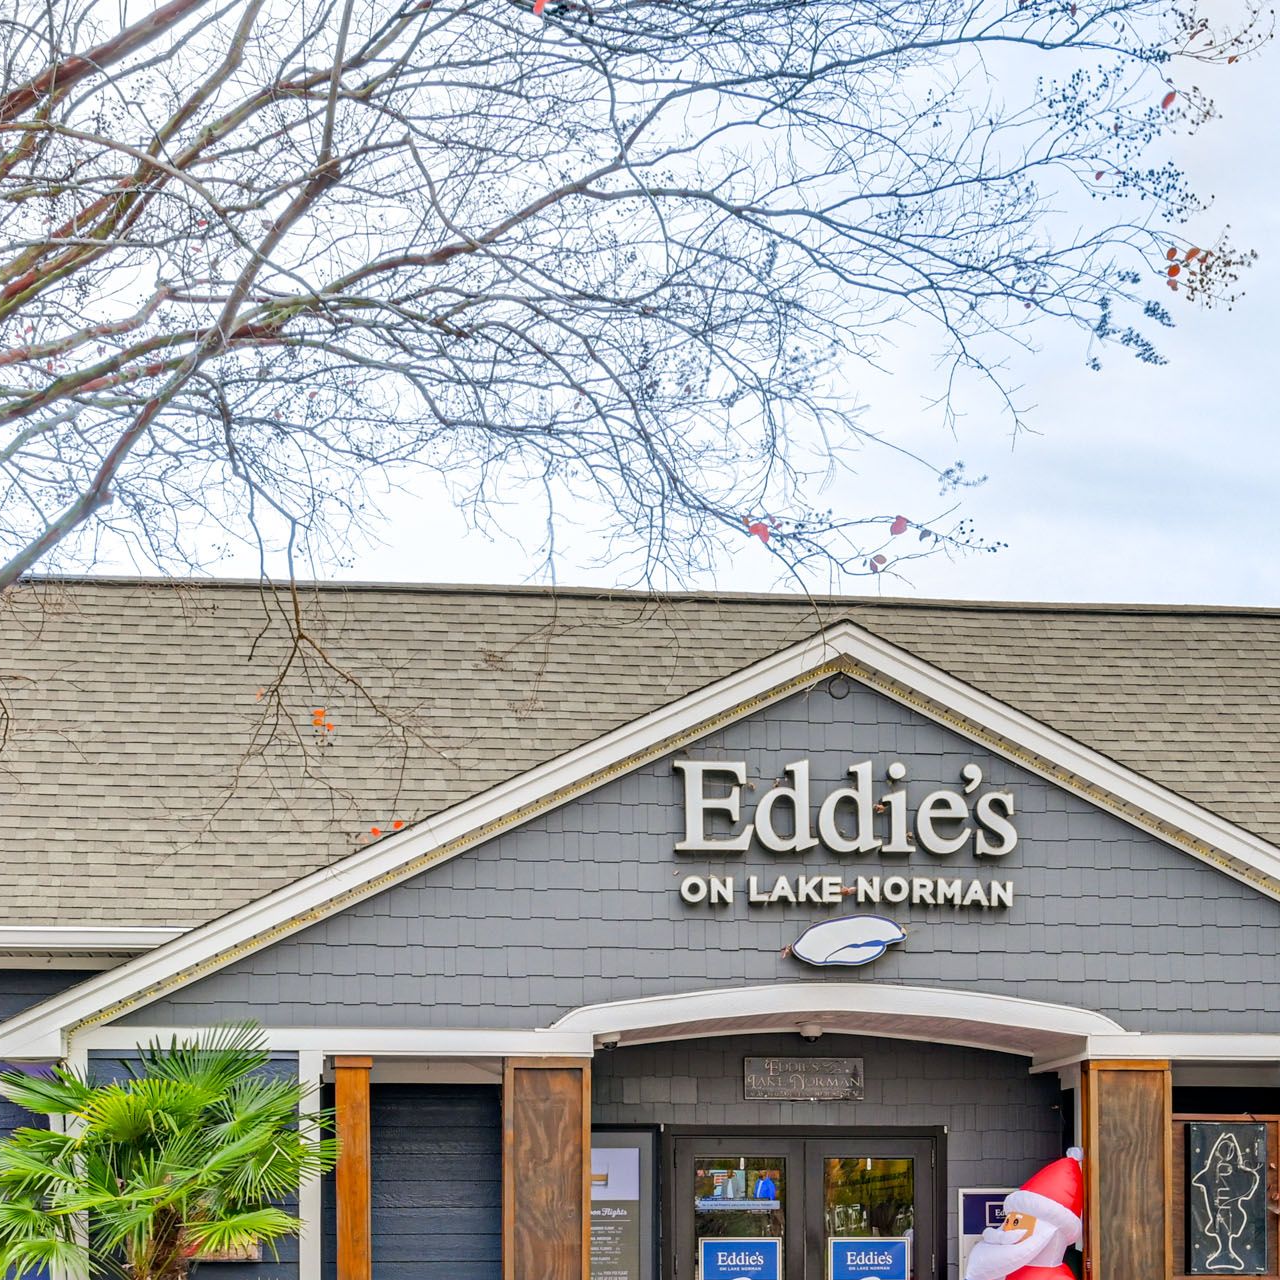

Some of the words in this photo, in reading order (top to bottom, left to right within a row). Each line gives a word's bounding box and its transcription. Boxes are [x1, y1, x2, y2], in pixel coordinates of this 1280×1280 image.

[673, 759, 1018, 857] Eddie's
[681, 875, 734, 904] ON
[749, 875, 843, 904] LAKE
[857, 876, 1014, 908] NORMAN
[717, 1251, 764, 1266] Eddie's
[846, 1251, 893, 1265] Eddie's
